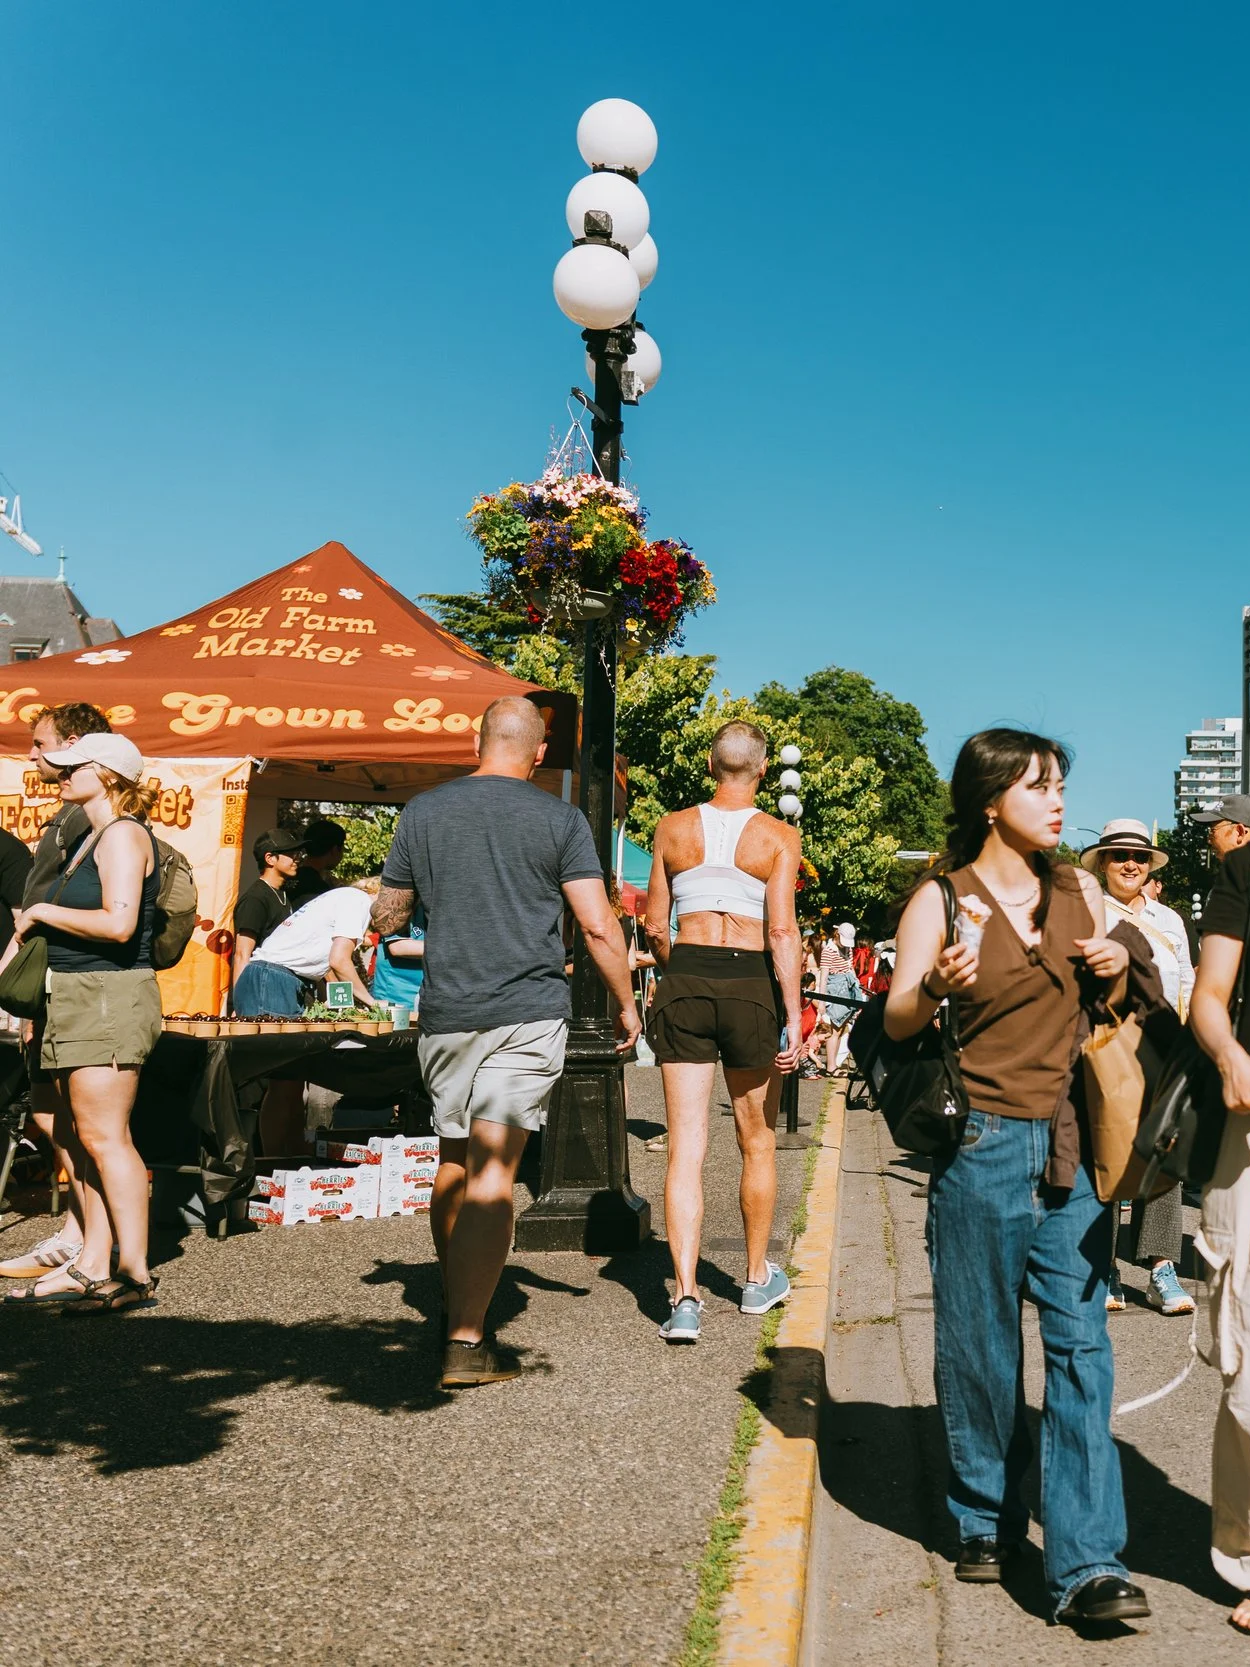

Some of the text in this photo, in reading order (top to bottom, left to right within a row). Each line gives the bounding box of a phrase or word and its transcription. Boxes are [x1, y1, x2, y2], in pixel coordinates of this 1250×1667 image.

[281, 587, 328, 603] The
[207, 606, 377, 634] Old Farm
[193, 631, 363, 666] Market
[161, 691, 368, 737] Grown
[0, 793, 64, 844] Far
